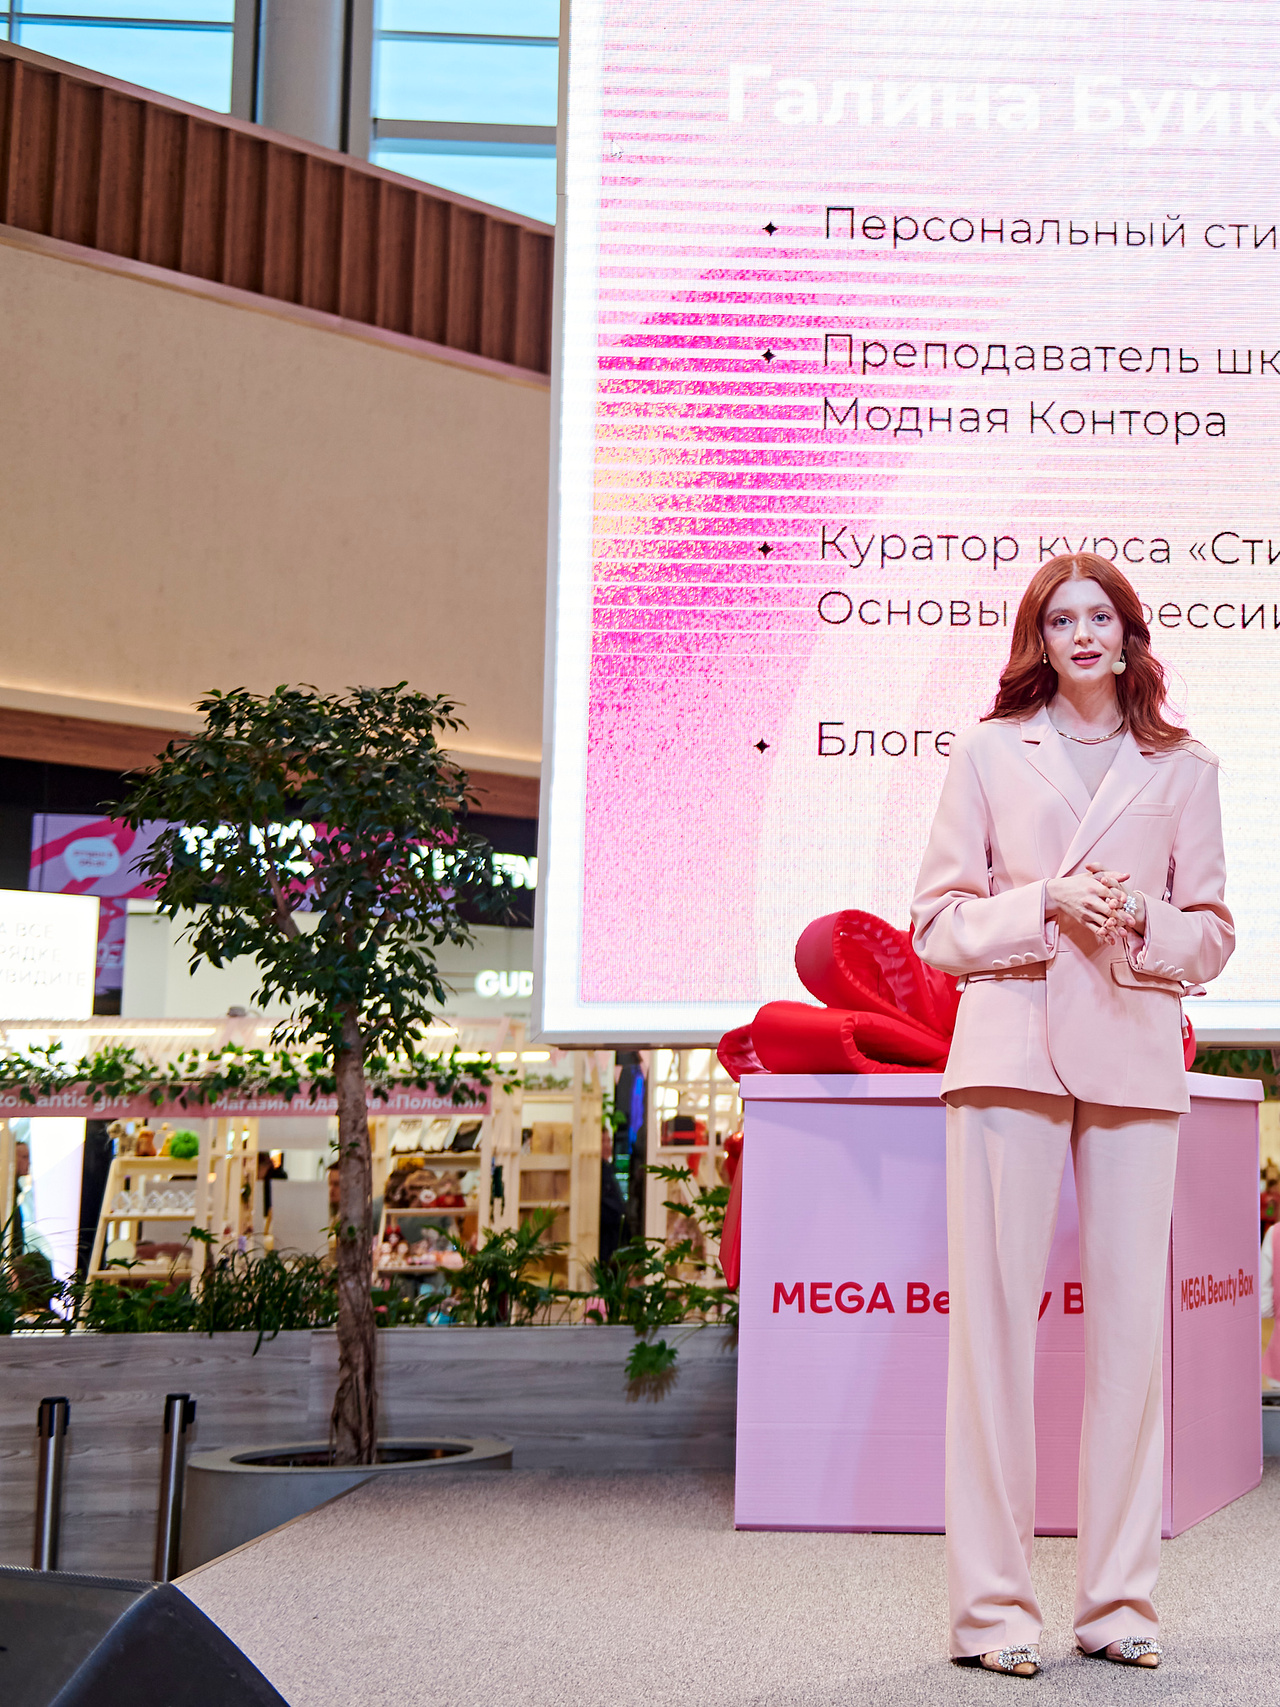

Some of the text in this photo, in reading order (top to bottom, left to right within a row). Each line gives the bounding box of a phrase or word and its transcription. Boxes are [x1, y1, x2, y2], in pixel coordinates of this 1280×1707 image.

[728, 63, 1040, 131] Галина
[825, 206, 1186, 250] Персональный
[821, 333, 1200, 377] Преподаватель
[819, 396, 1227, 446] Модная Контора
[819, 524, 1020, 572] Куратор
[816, 590, 1008, 628] Основы
[817, 721, 955, 758] Блоге
[772, 1281, 896, 1315] MEGA
[1181, 1268, 1254, 1312] MEGA Beauty Box
